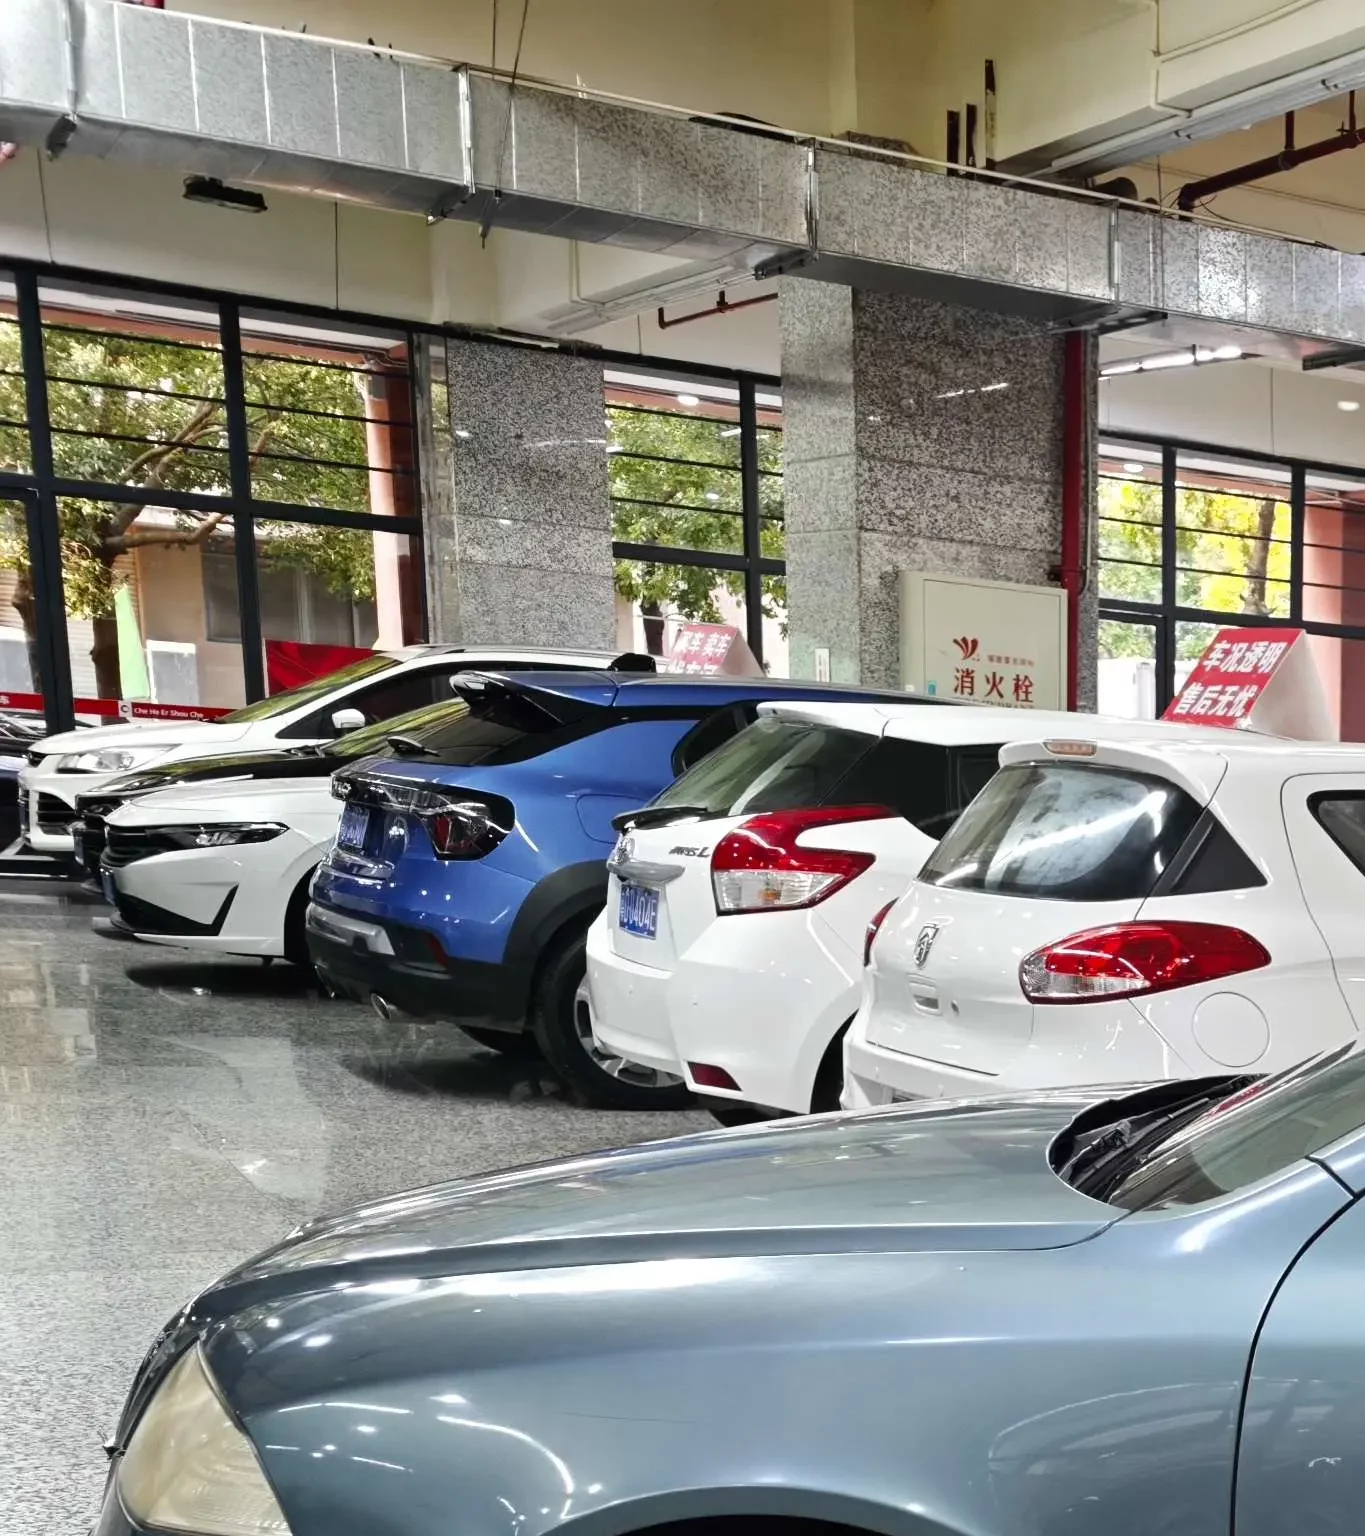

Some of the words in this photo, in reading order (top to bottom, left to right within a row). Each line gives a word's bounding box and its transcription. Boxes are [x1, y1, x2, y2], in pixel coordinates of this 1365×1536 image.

[1203, 640, 1288, 673] 车况透明
[953, 667, 1034, 703] 消火栓
[1173, 682, 1258, 717] 售后无忧
